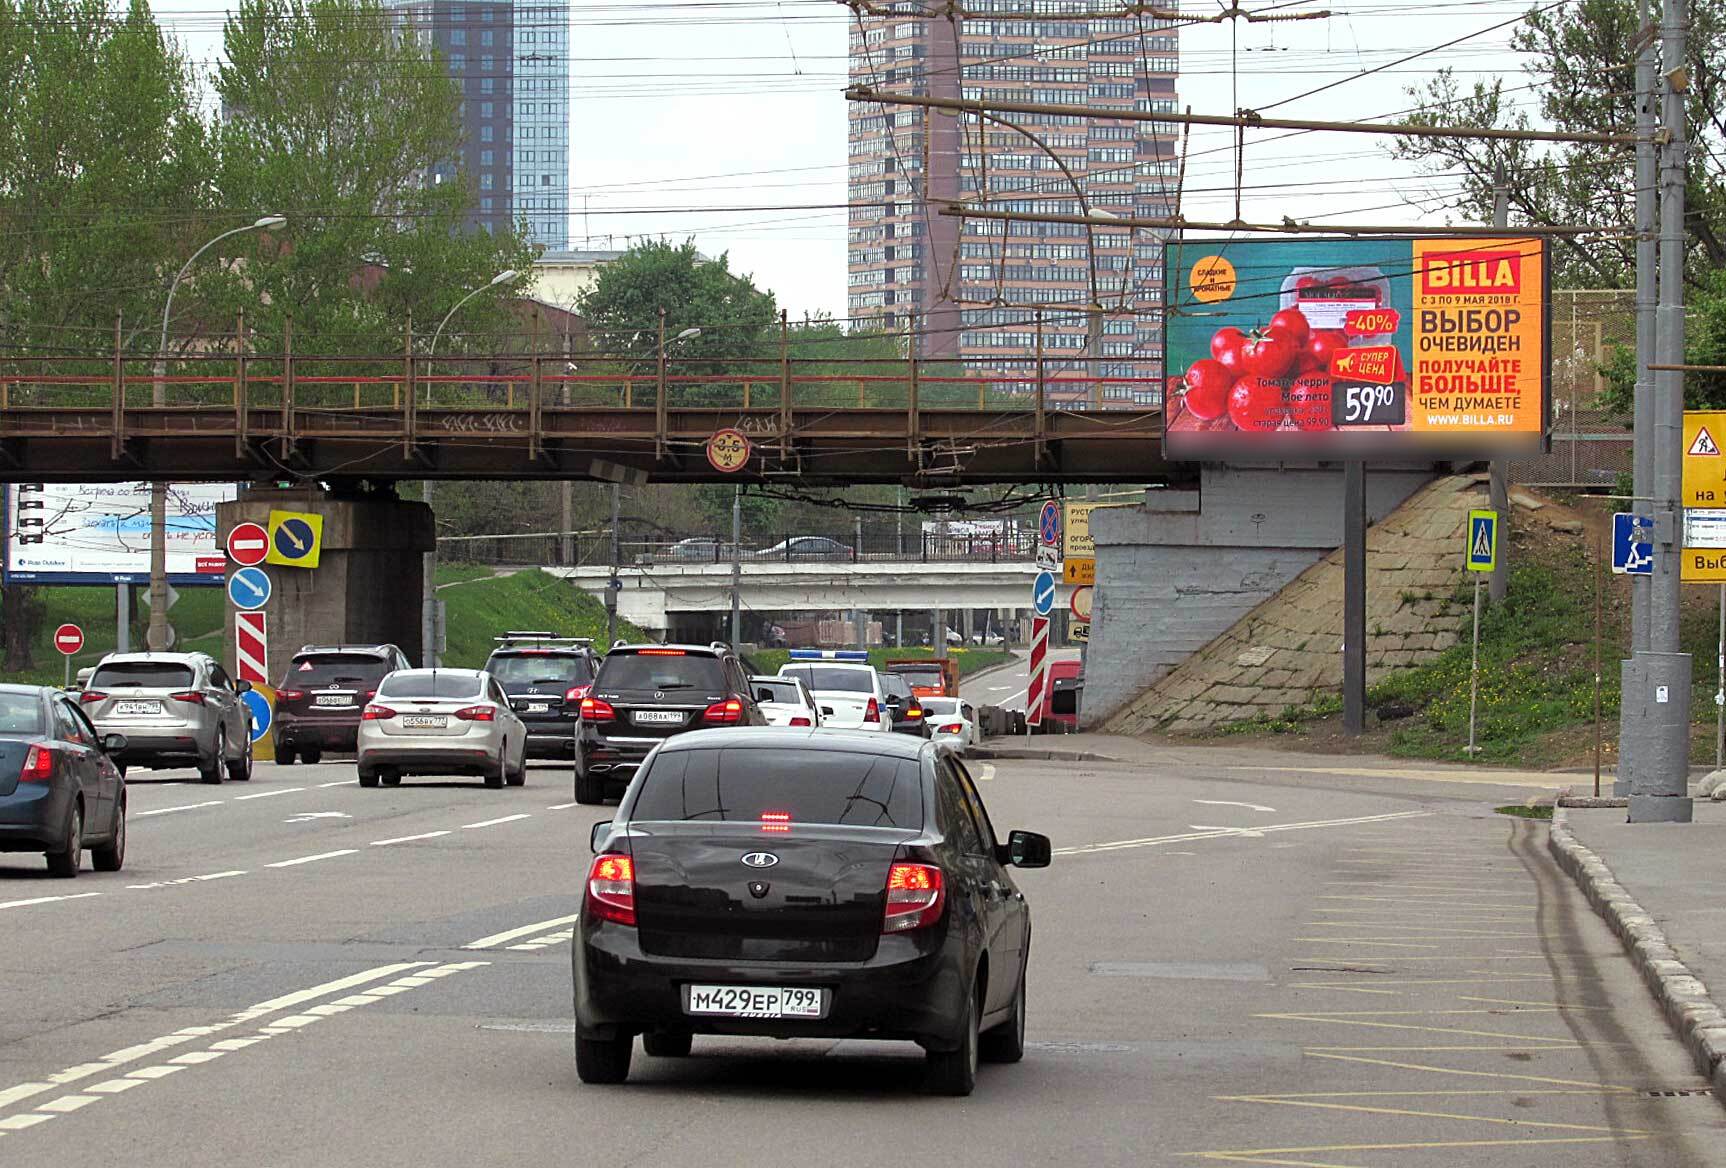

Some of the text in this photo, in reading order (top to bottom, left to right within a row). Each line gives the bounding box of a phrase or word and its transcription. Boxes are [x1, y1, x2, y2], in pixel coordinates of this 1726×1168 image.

[1428, 260, 1515, 287] BILLA
[1430, 296, 1436, 304] 3
[1439, 296, 1452, 304] ПО
[1454, 296, 1460, 304] 9
[1463, 296, 1485, 304] МАЯ
[1487, 296, 1511, 304] 2018
[1348, 315, 1393, 331] -40%
[1421, 309, 1521, 333] ВЫБОР
[1419, 336, 1521, 354] ОЧЕВИДЕН
[1360, 352, 1389, 362] СУПЕР
[1419, 356, 1521, 373] ПОЛУЧАЙТЕ
[1358, 363, 1385, 375] ЦЕНА
[1420, 375, 1521, 395] БОЛЬШЕ,
[1419, 397, 1521, 412] ЧЕМ ДУМАЕТЕ
[1427, 414, 1514, 425] WWW.BILLA.RU
[1695, 491, 1715, 501] на
[696, 988, 815, 1011] М429ЕР 799
